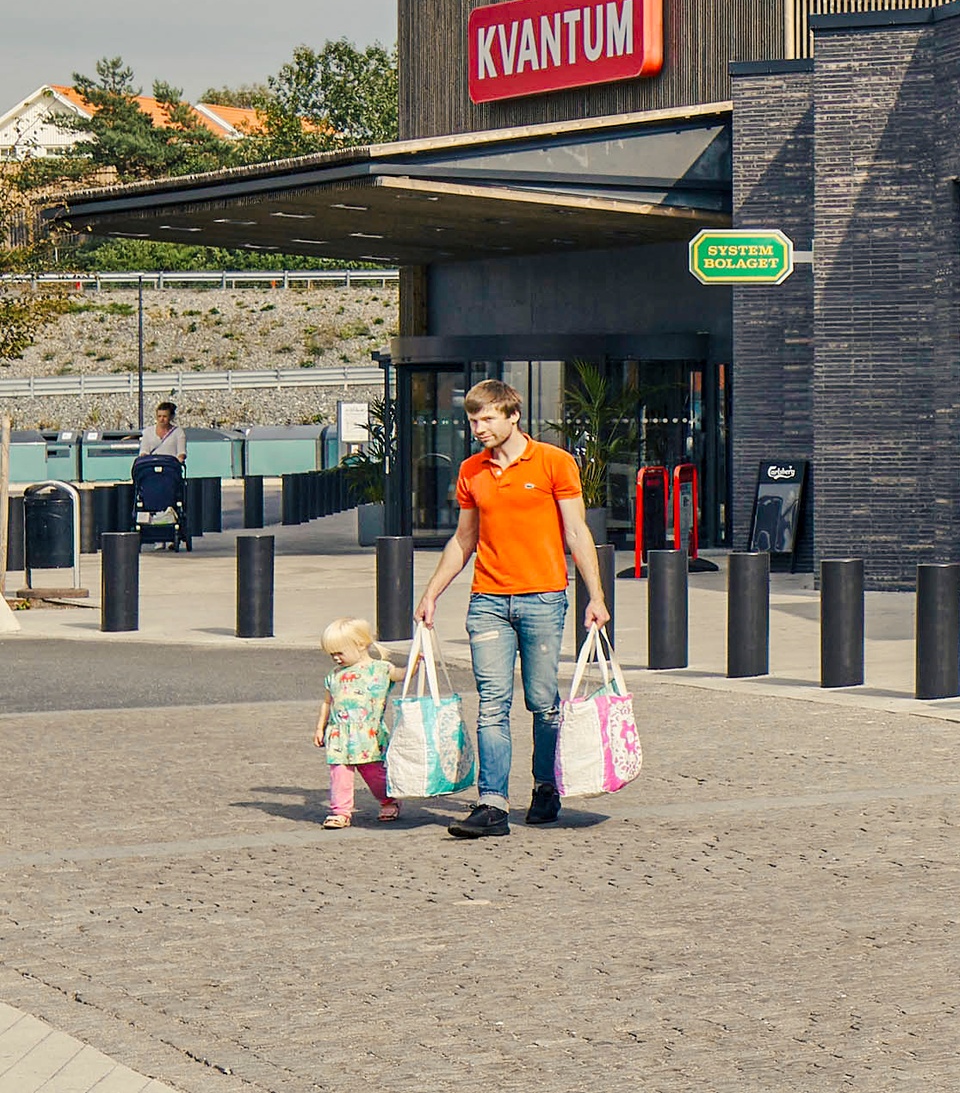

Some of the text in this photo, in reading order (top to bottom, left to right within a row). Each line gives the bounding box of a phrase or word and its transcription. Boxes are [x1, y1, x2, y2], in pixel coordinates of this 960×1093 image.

[707, 245, 774, 256] SYSTEM
[703, 258, 779, 269] BOLAGET
[767, 465, 796, 480] Carlsberg
